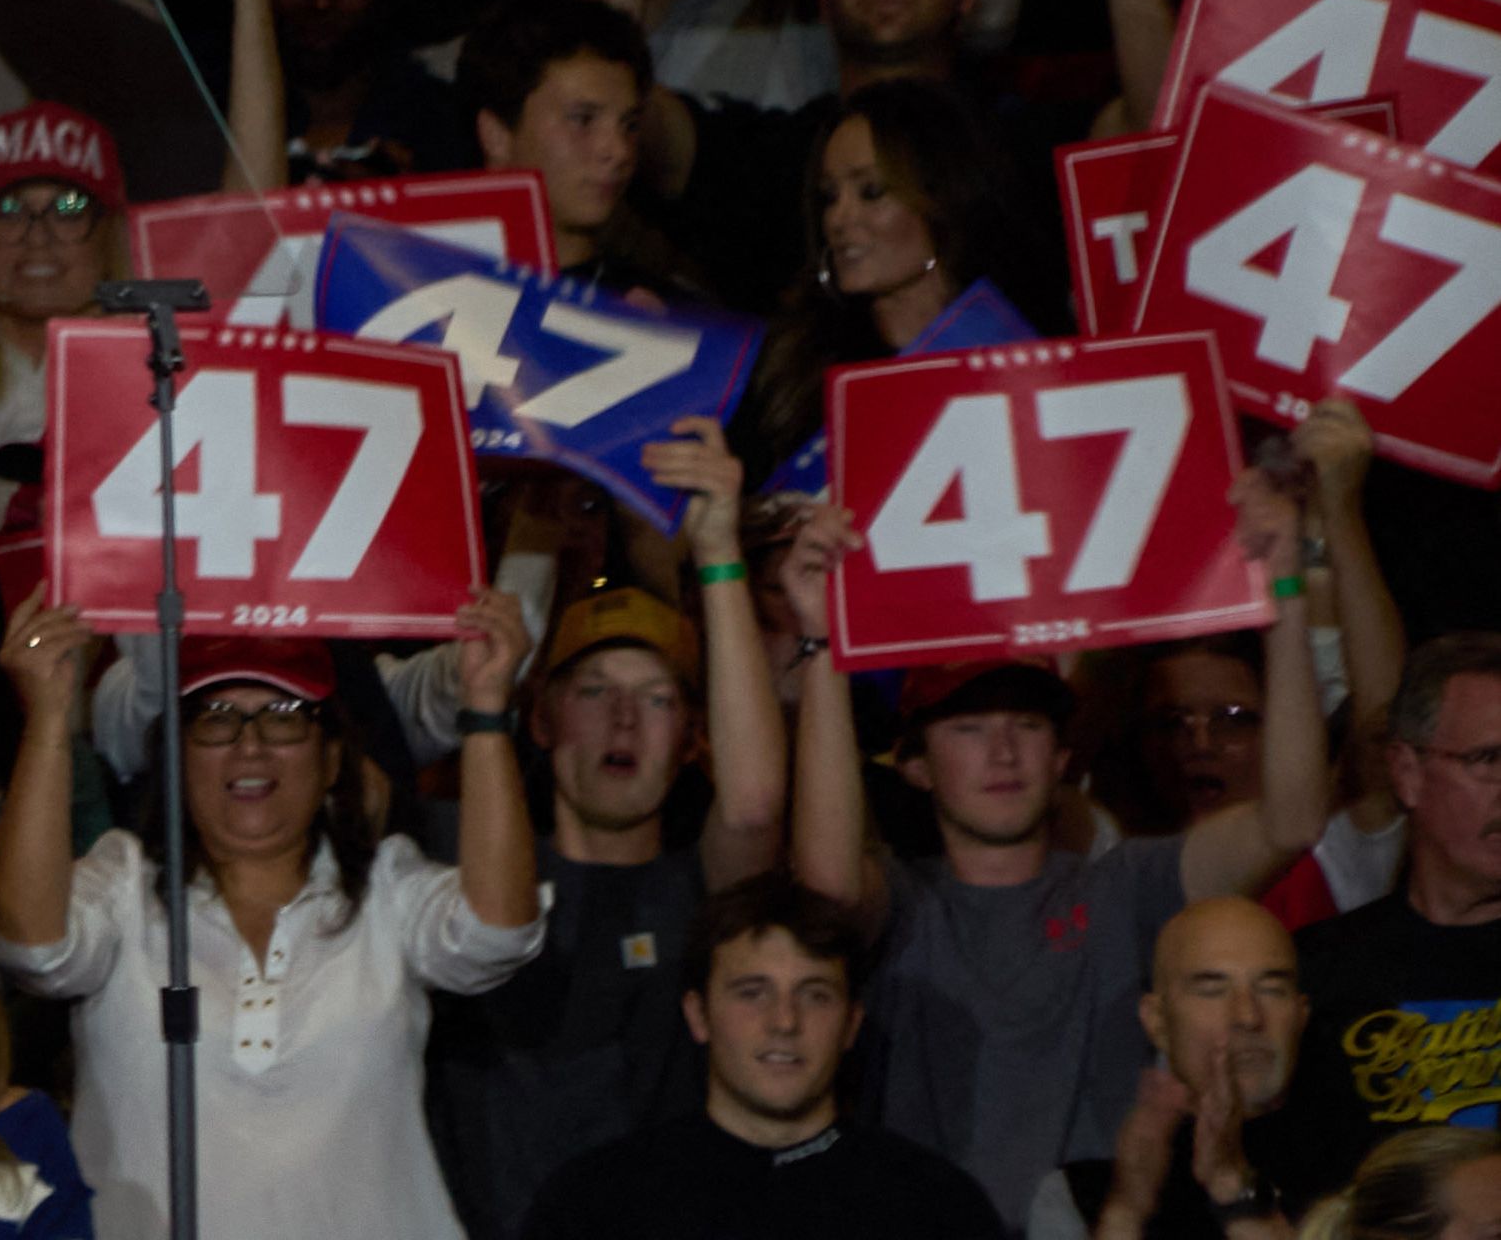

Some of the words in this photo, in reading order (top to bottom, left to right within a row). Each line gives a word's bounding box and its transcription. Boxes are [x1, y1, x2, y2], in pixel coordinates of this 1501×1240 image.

[353, 272, 704, 429] 47
[1184, 162, 1501, 405] 47
[90, 369, 426, 582] 47
[866, 372, 1195, 604] 47
[231, 605, 308, 628] 2024
